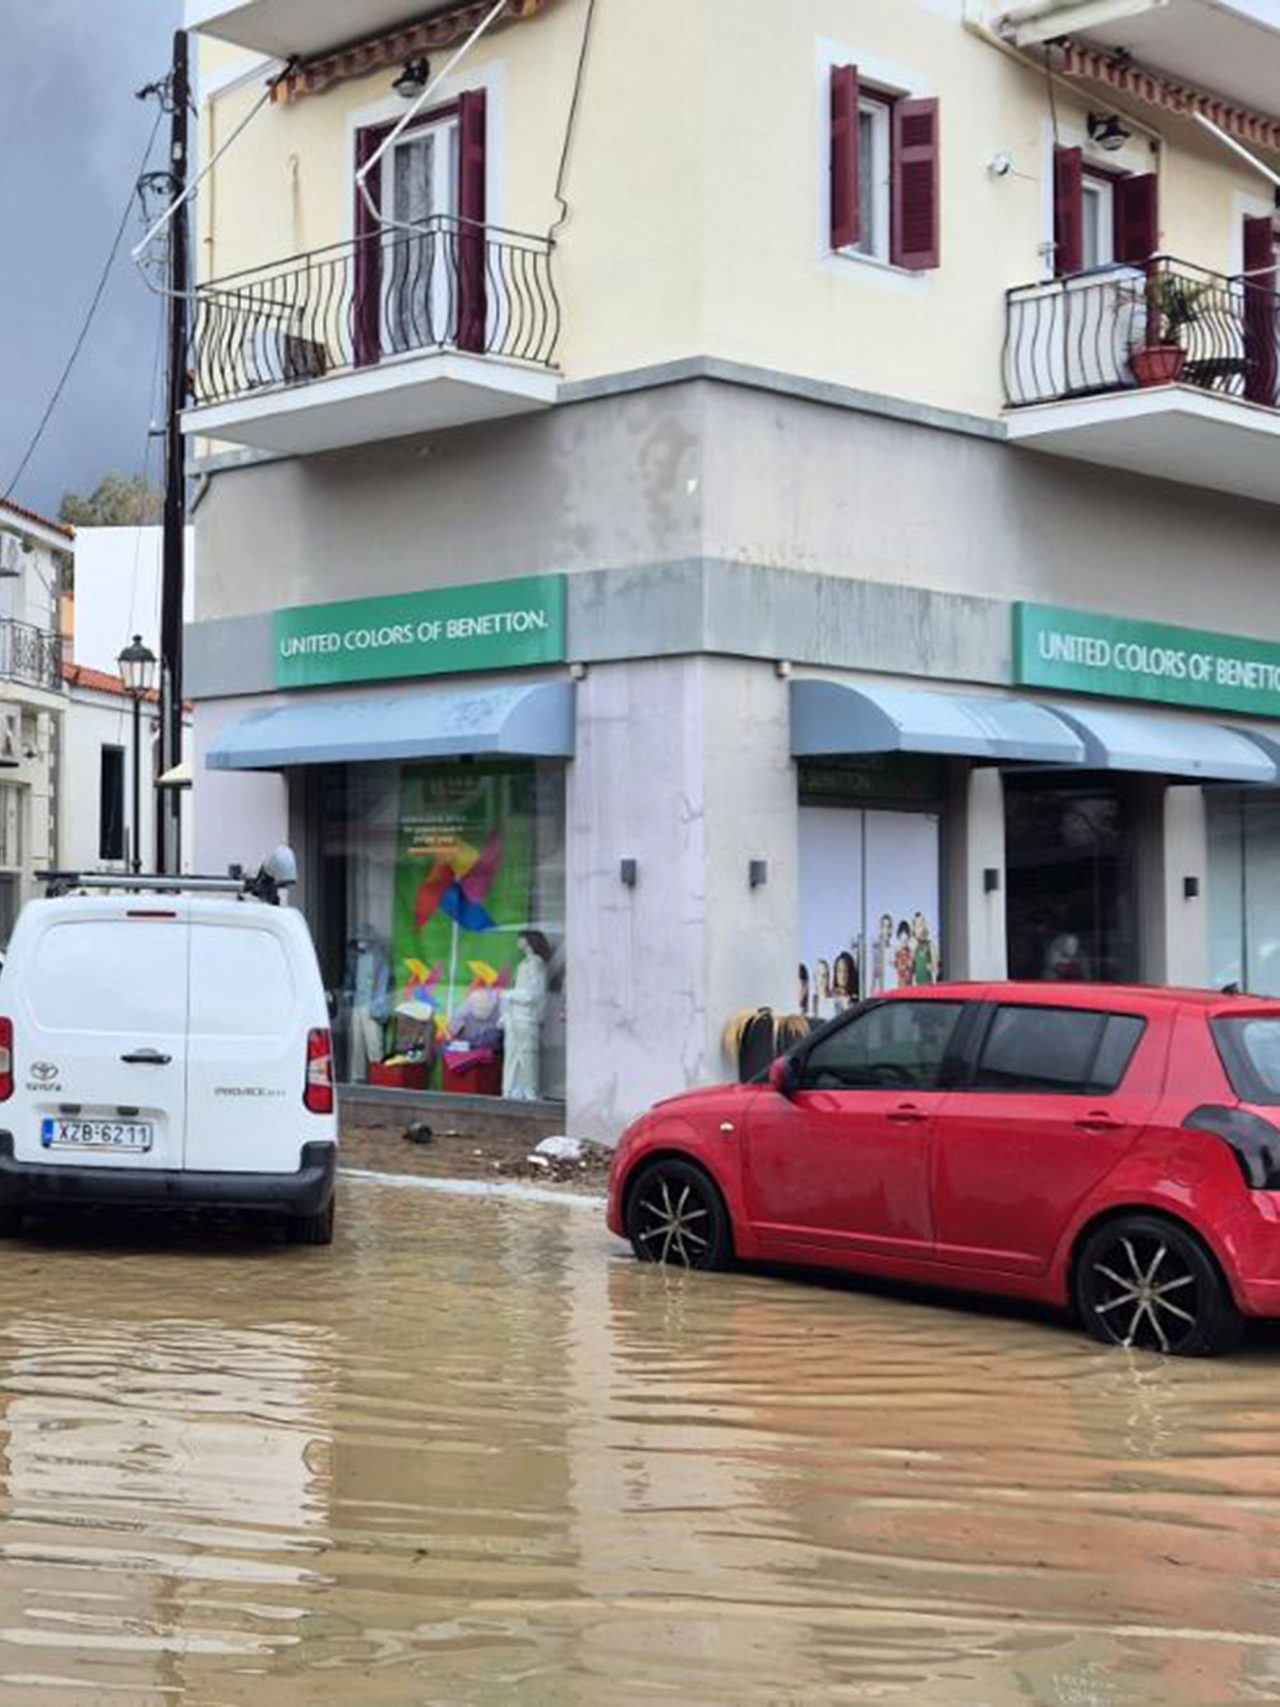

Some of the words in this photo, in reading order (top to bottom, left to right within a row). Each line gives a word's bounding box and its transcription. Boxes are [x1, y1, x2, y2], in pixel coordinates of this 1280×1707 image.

[280, 632, 340, 657] UNITED
[344, 622, 413, 649] COLORS
[417, 618, 442, 642] OF
[1037, 631, 1110, 667] UNITED
[1113, 642, 1187, 679] COLORS
[1188, 653, 1214, 681] OF
